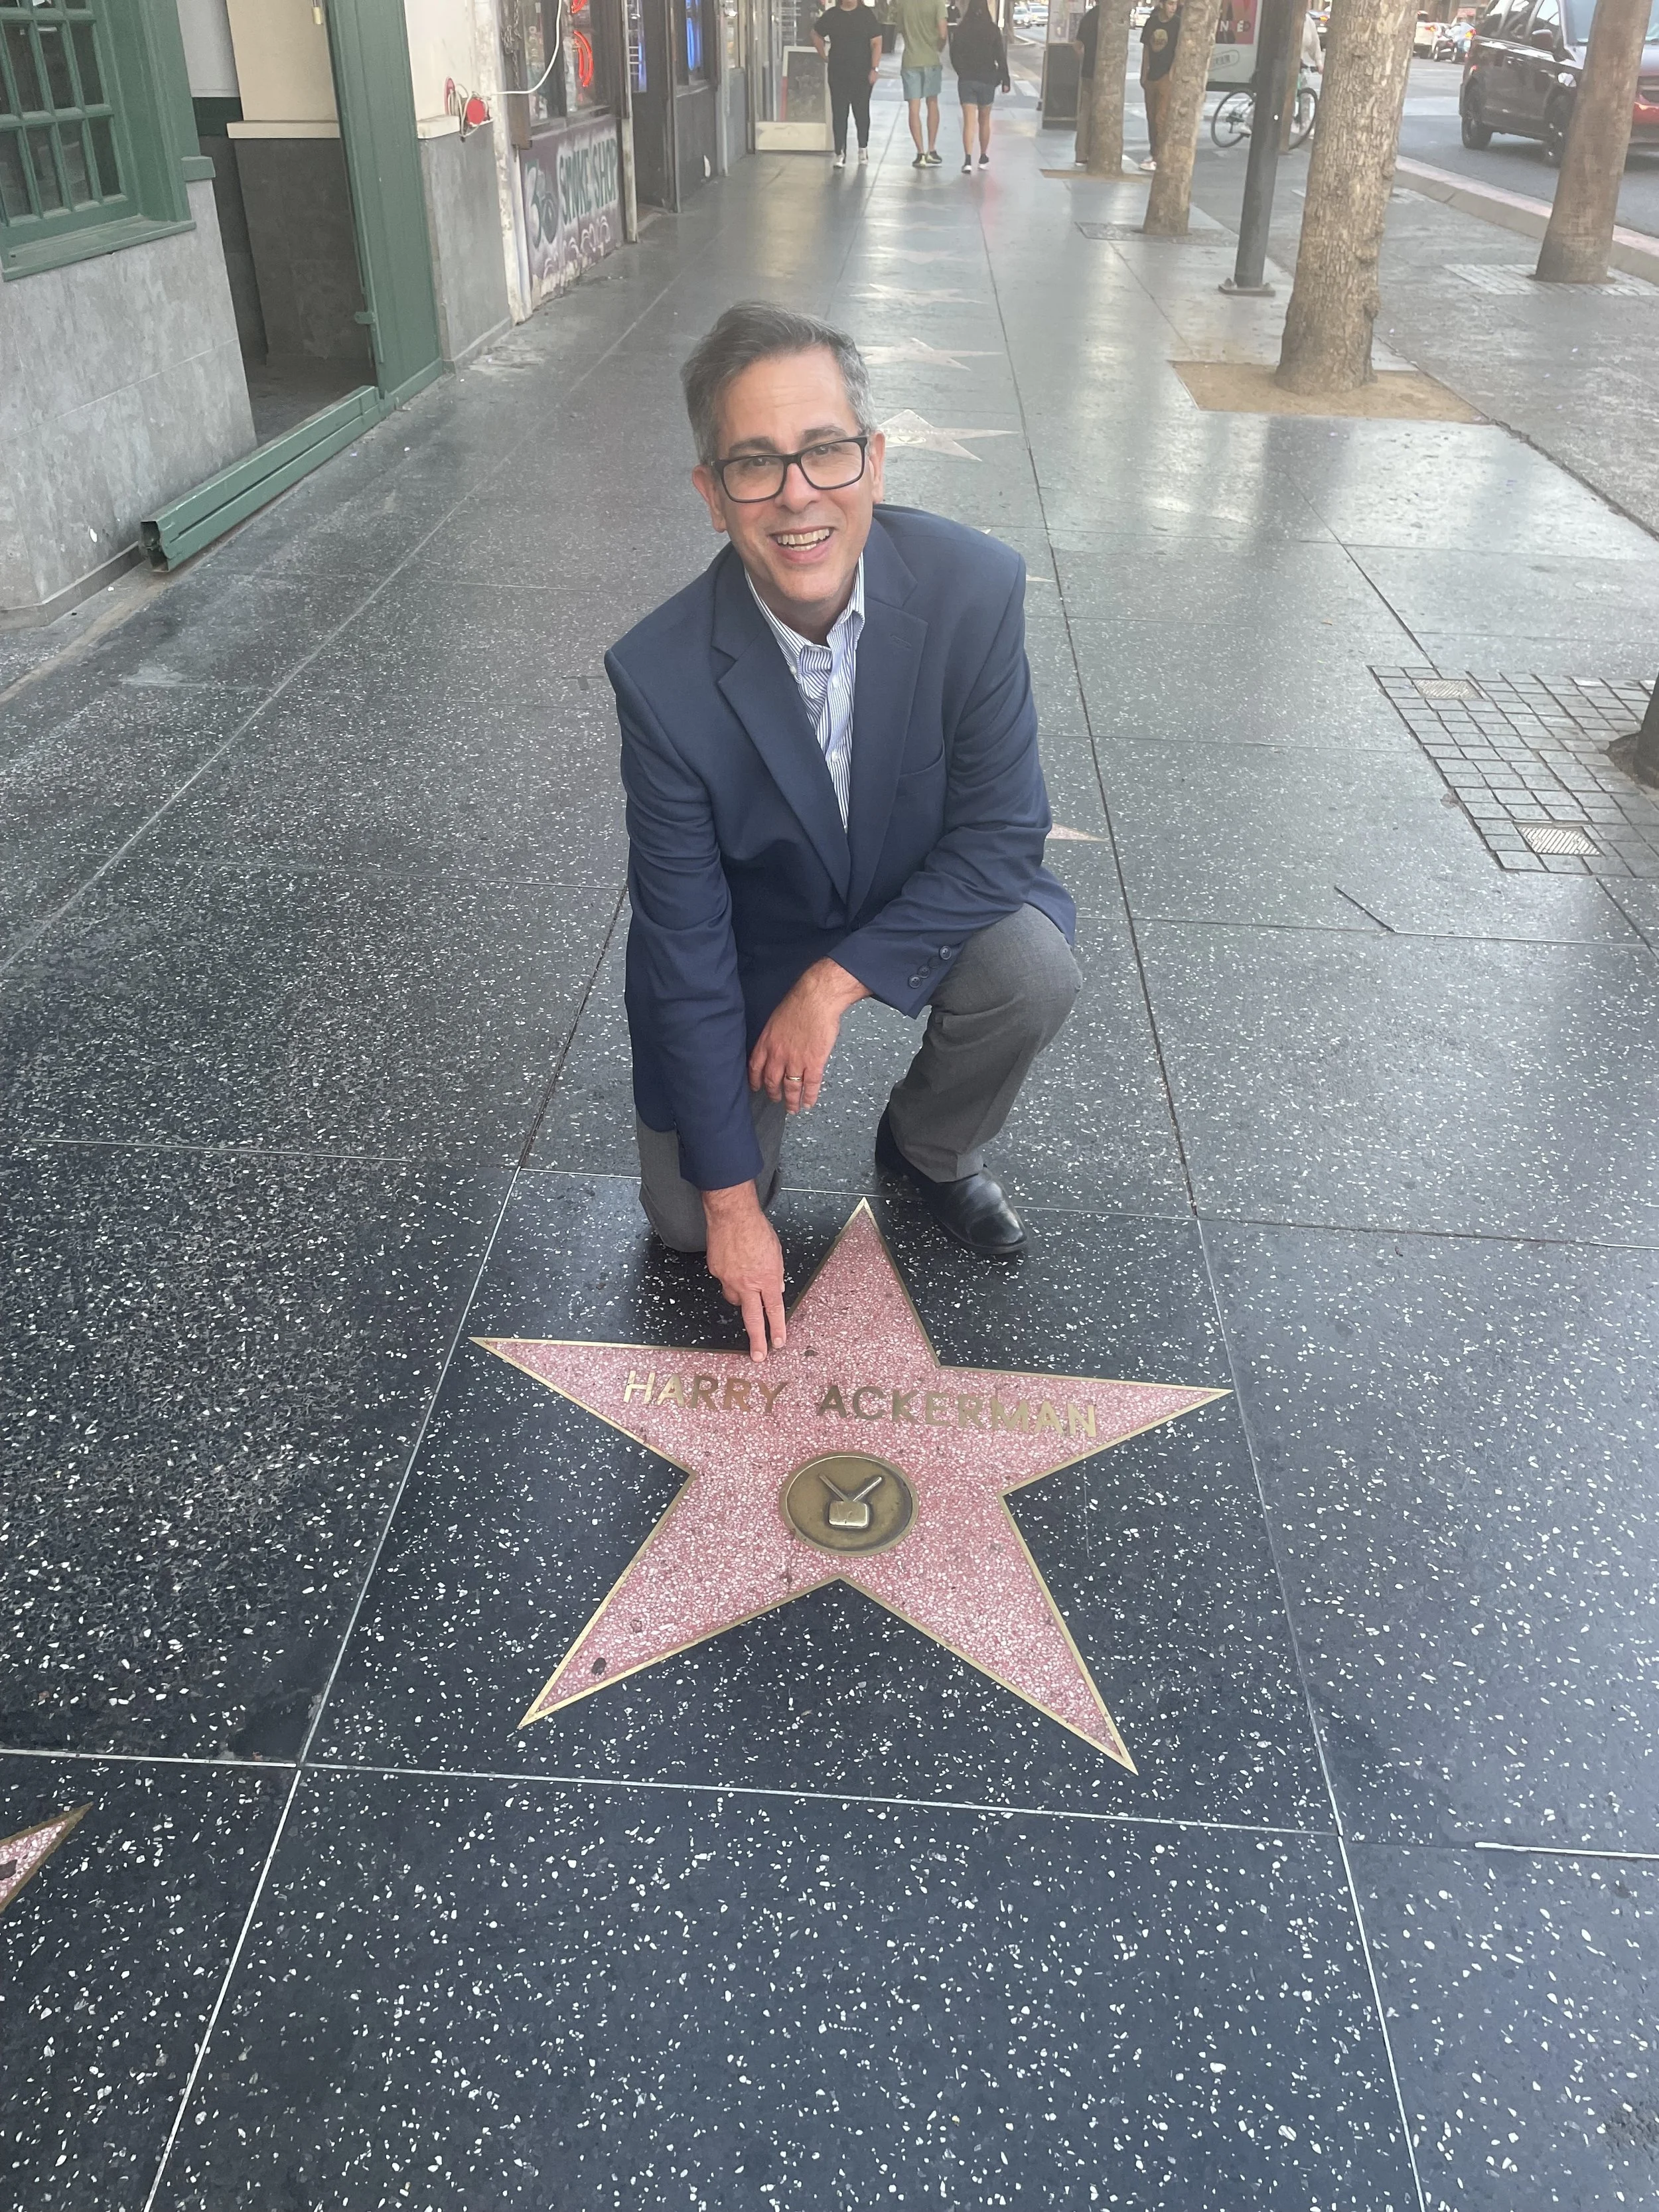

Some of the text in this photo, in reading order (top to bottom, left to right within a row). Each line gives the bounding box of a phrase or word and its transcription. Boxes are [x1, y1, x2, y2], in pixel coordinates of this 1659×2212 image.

[559, 137, 618, 226] SMOKE SHOP
[622, 1370, 1096, 1438] HARRY ACKERMAN
